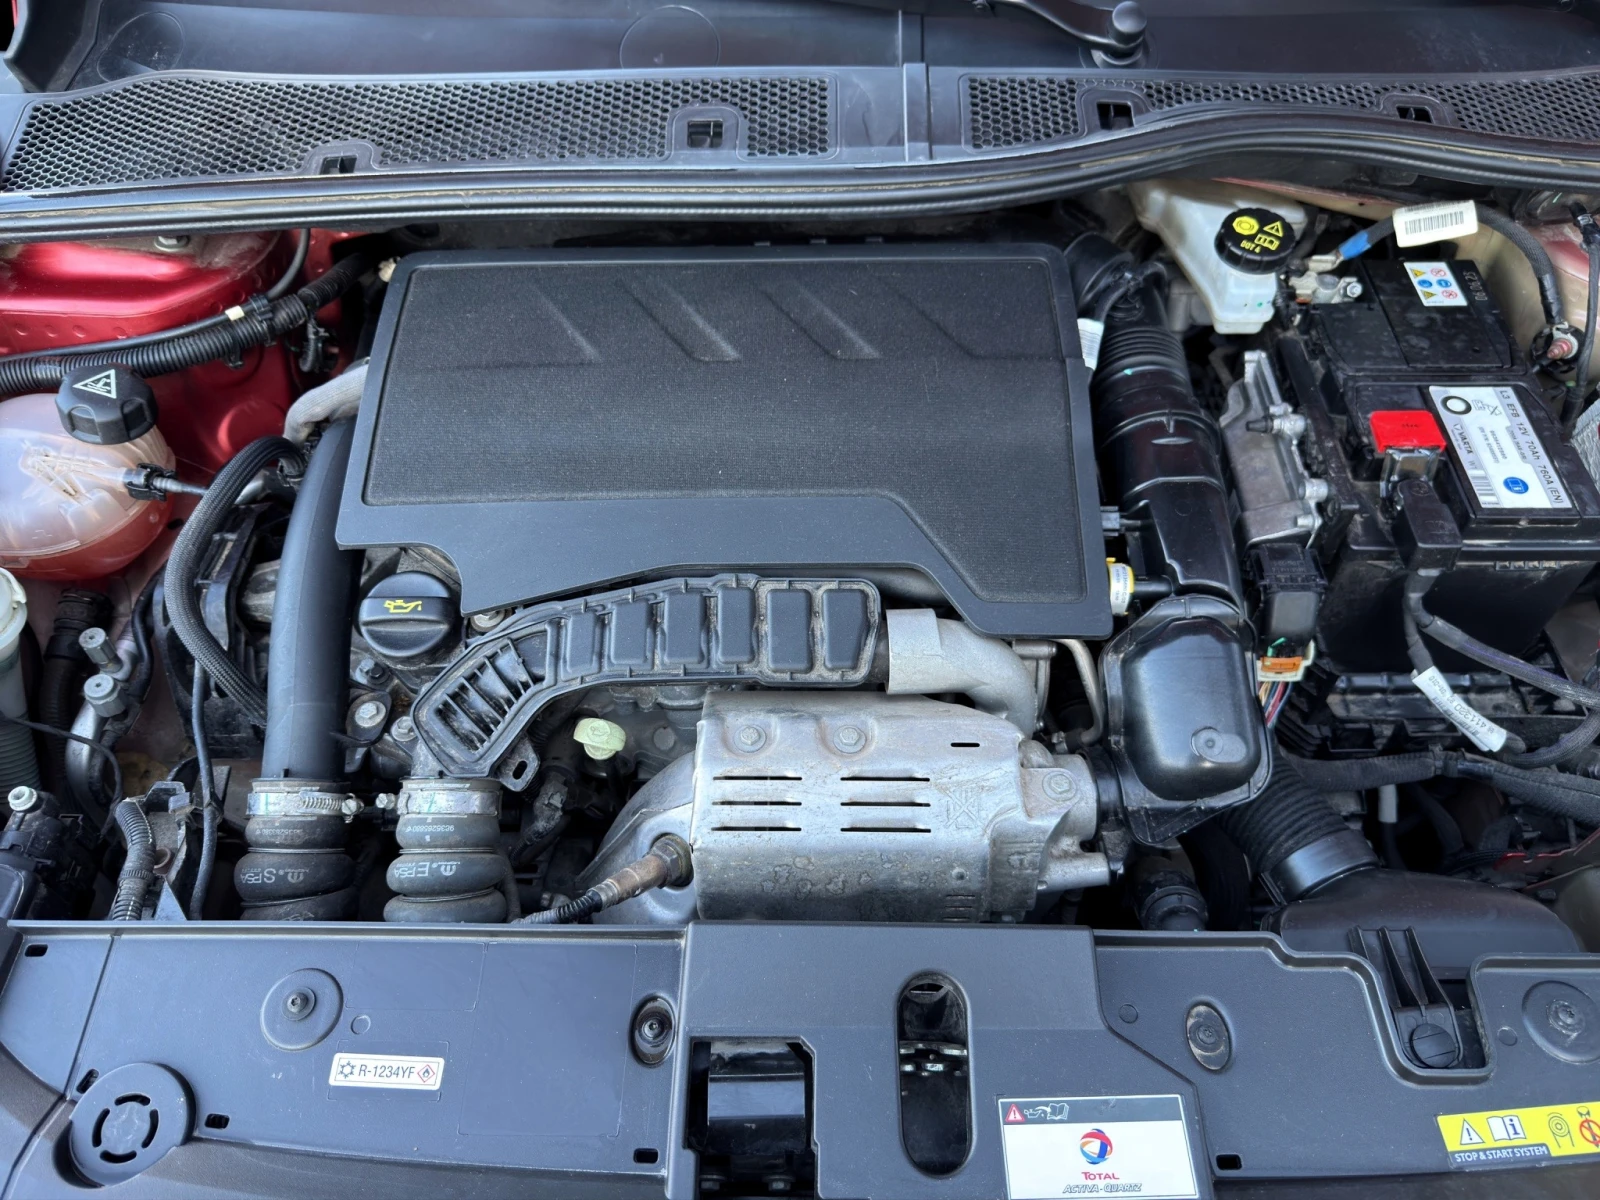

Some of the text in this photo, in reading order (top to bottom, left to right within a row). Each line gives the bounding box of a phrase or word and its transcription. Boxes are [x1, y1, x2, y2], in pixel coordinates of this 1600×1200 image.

[1458, 431, 1474, 454] VARTA
[1506, 403, 1520, 418] EFB
[1516, 422, 1530, 437] 12V
[1525, 440, 1541, 460] 70Ah
[1538, 464, 1554, 486] 760A
[1547, 486, 1564, 504] (EN)
[240, 873, 262, 884] PSA
[358, 1064, 416, 1079] R-1234YF
[1454, 1145, 1548, 1162] STOP & START SYSTEM
[1081, 1171, 1120, 1181] TOTAL
